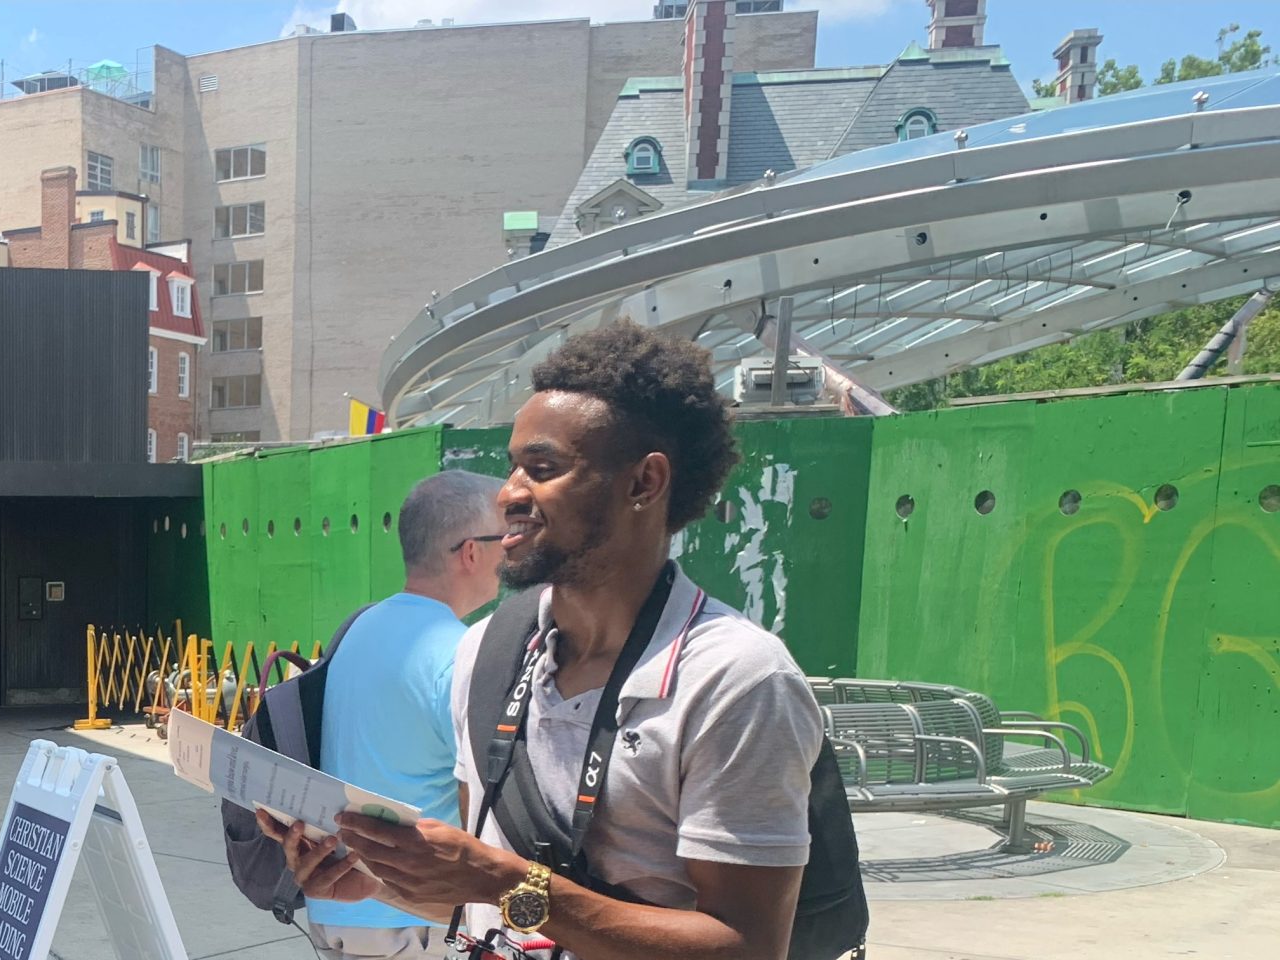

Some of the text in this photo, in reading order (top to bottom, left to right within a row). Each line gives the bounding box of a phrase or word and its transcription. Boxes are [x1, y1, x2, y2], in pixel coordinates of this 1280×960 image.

[506, 648, 540, 717] SONY
[9, 815, 65, 862] CHRISTIAN
[4, 849, 47, 893] SCIENCE
